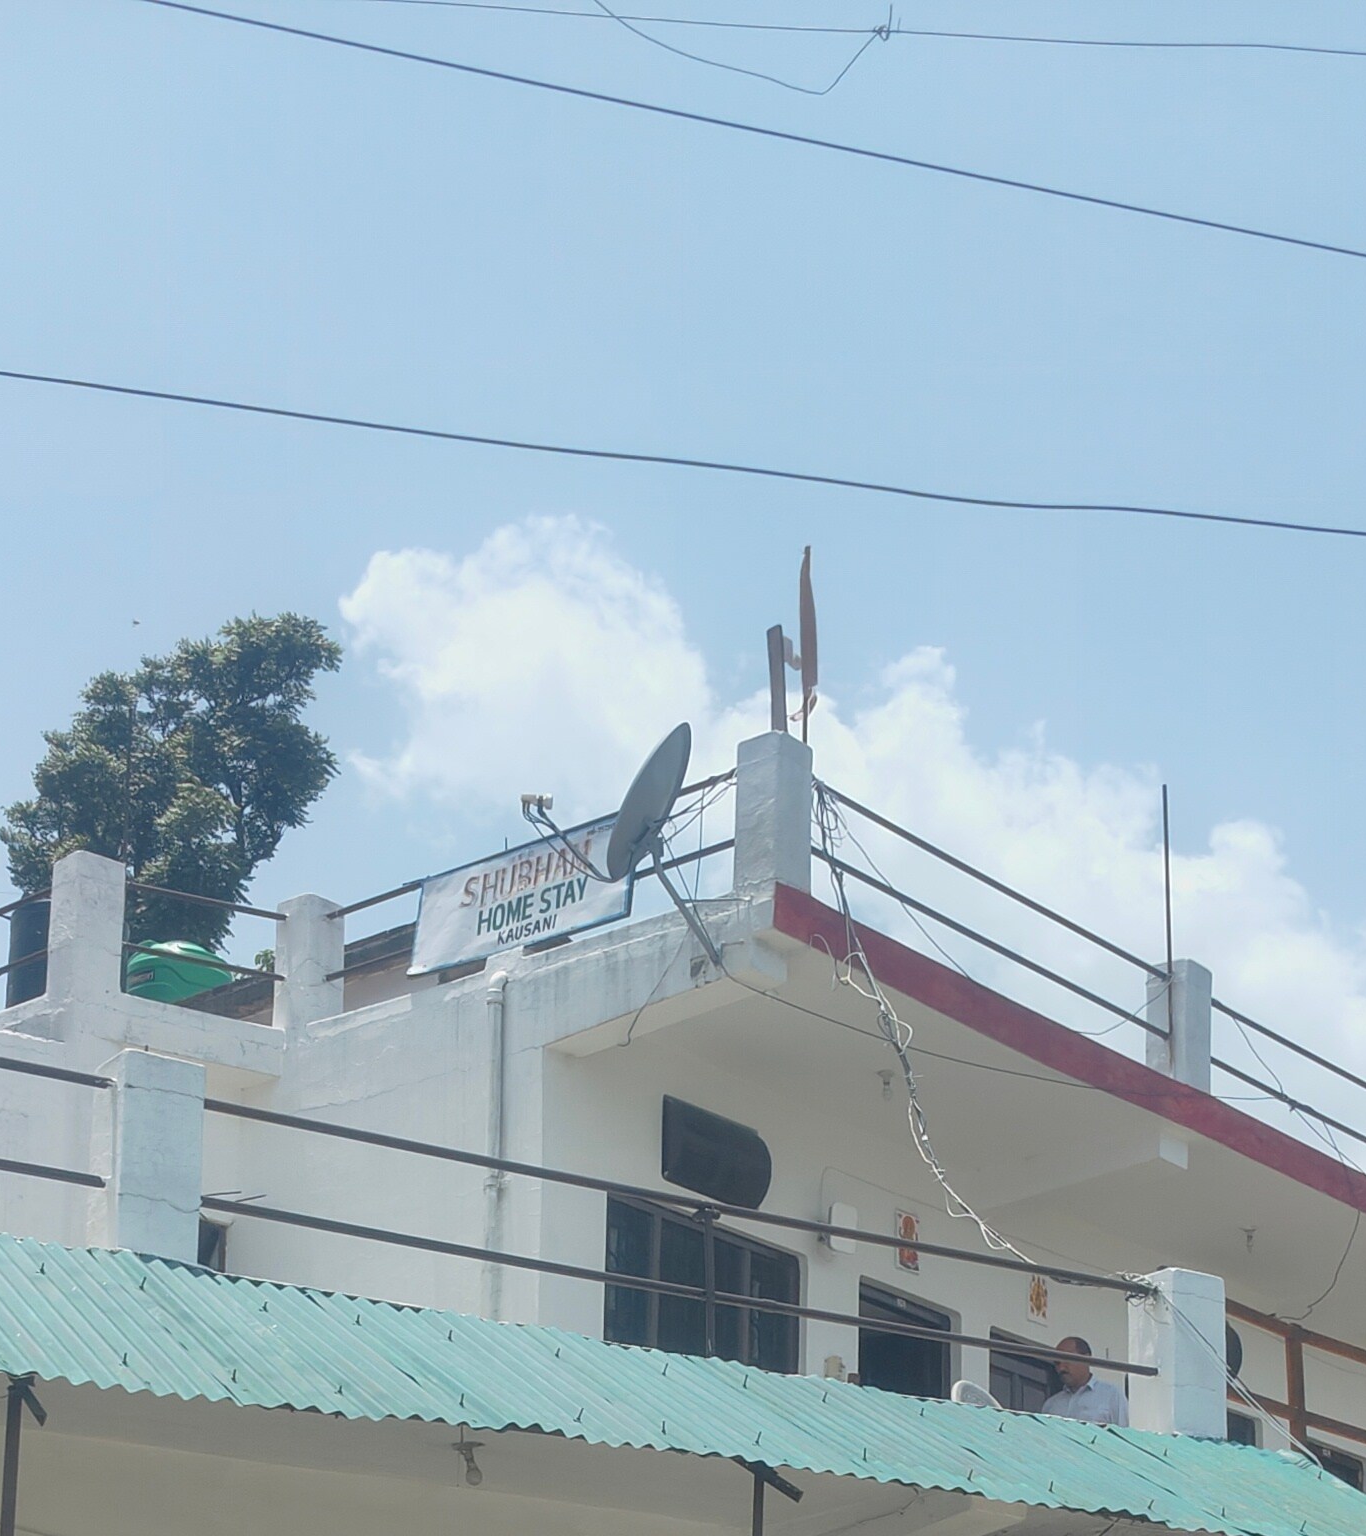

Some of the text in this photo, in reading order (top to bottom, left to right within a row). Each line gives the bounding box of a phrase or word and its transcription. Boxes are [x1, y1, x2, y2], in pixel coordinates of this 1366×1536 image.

[459, 839, 592, 908] SHUBHAM
[477, 876, 588, 936] HOME STAY
[497, 914, 558, 945] KAUSANI
